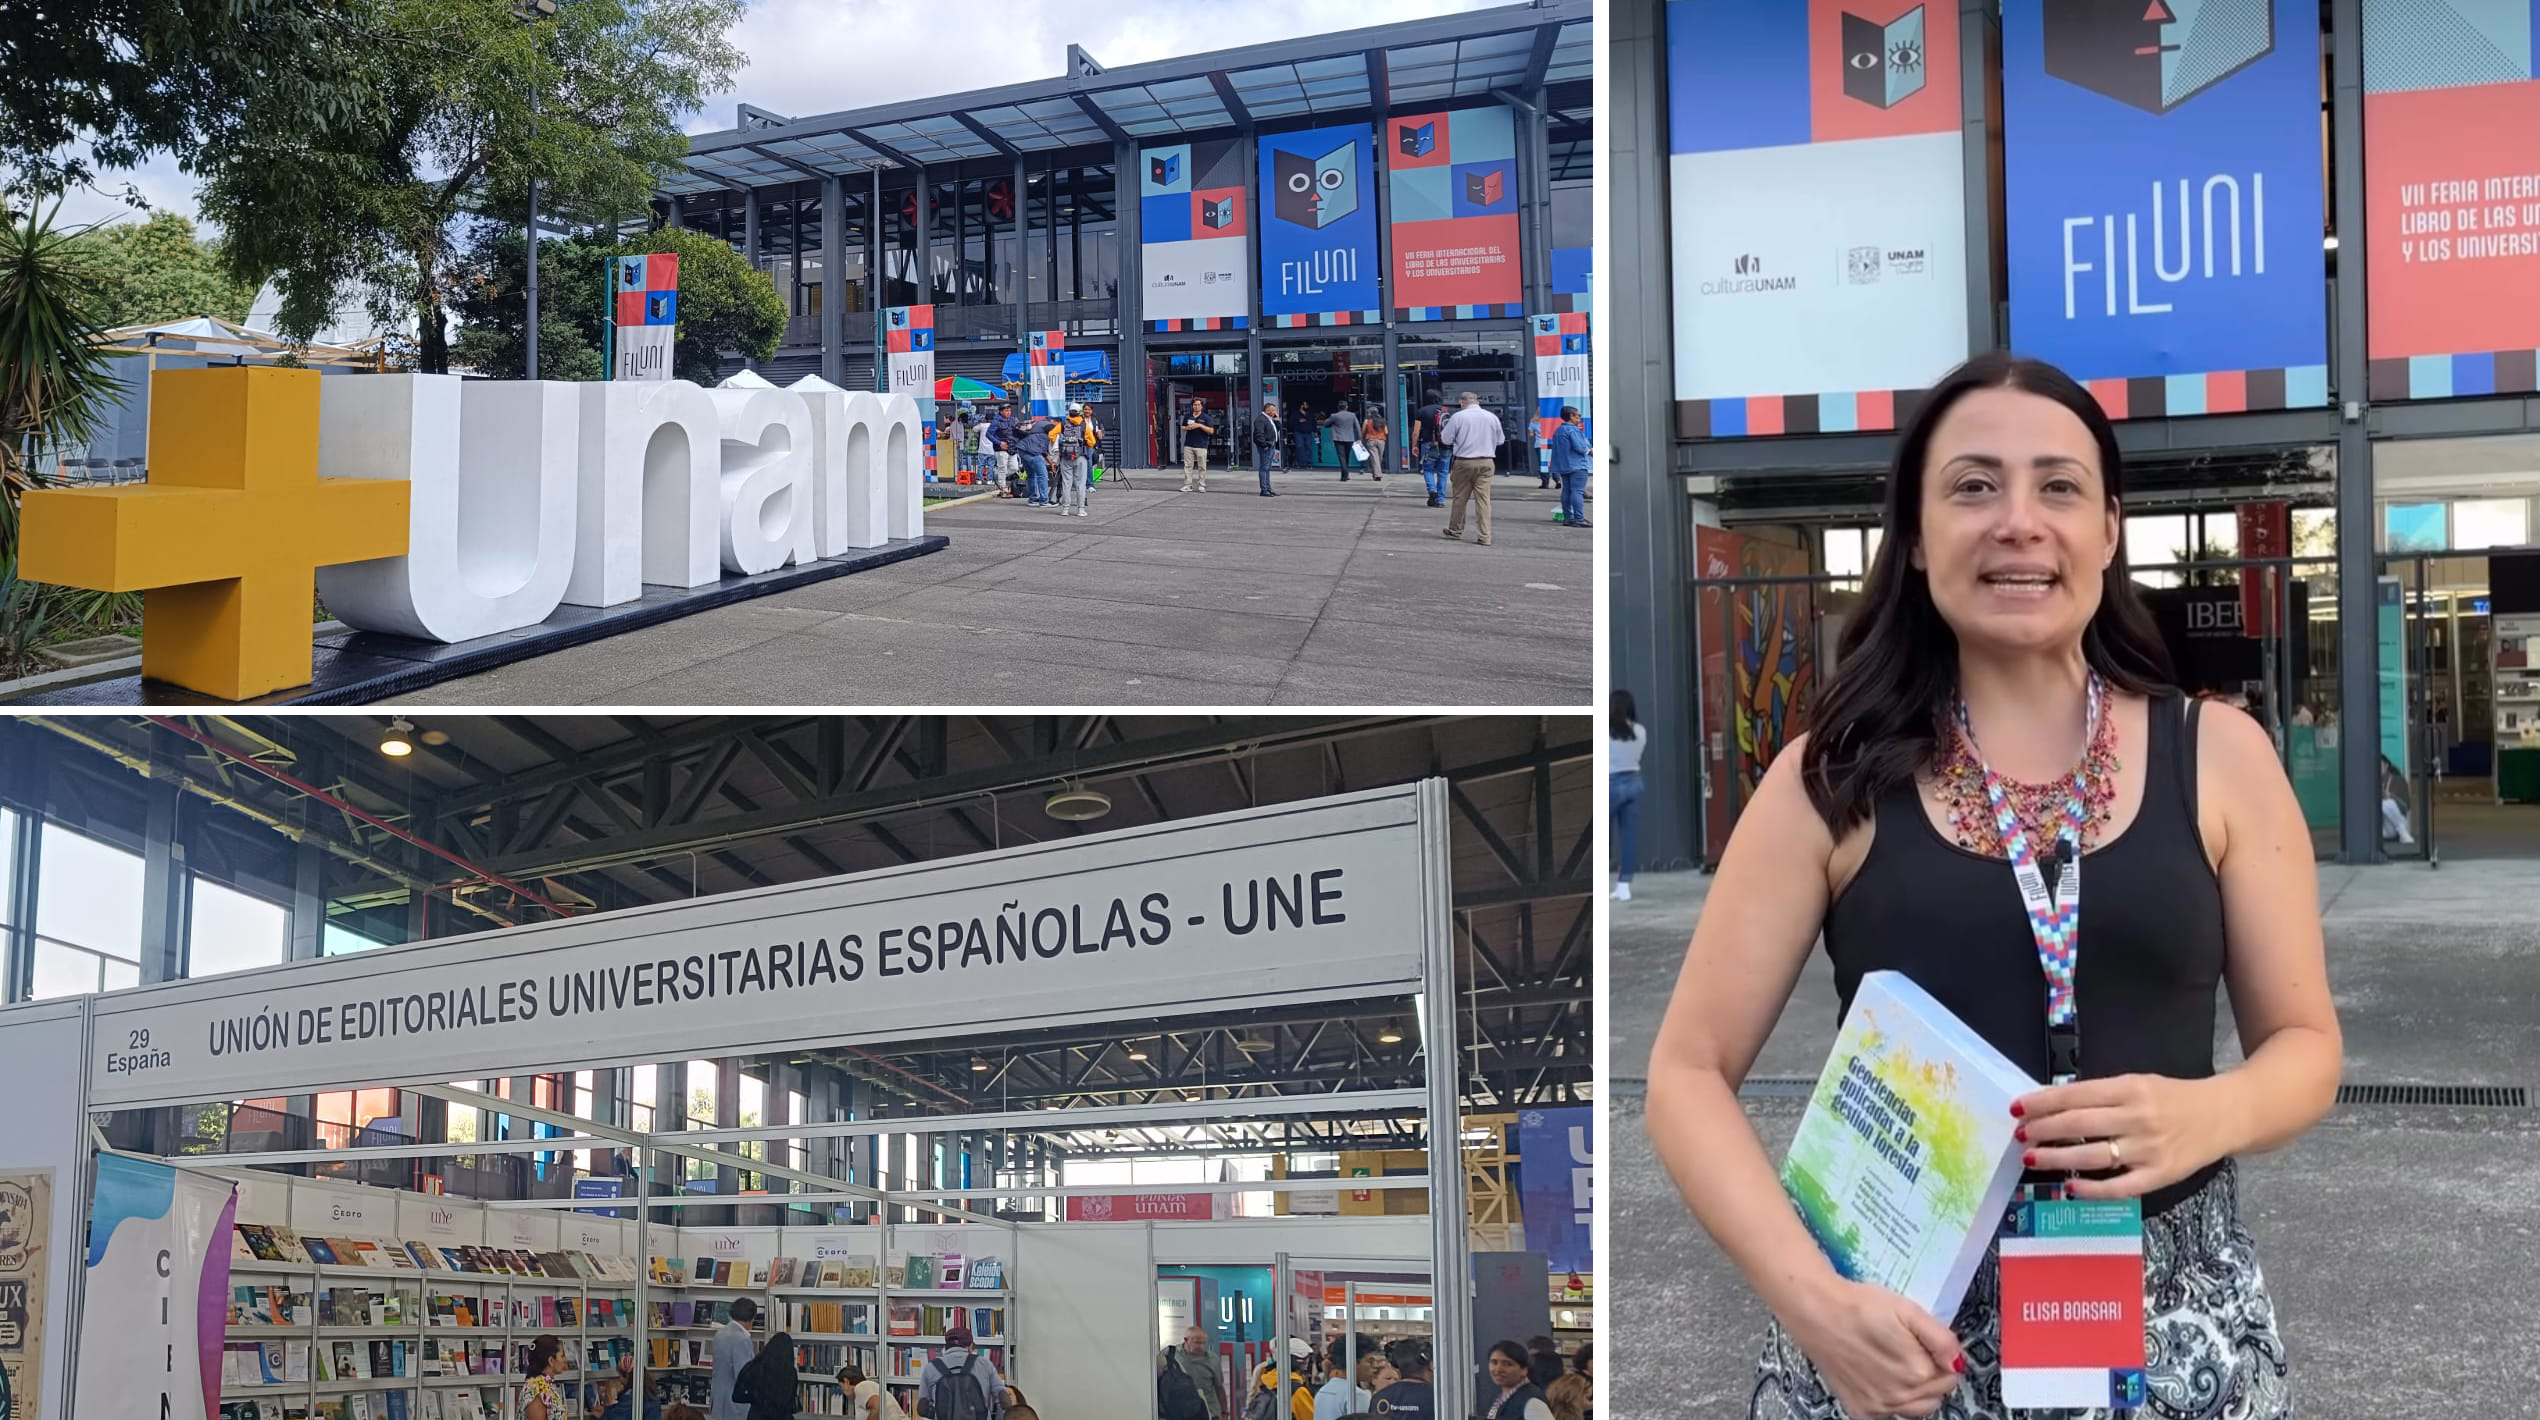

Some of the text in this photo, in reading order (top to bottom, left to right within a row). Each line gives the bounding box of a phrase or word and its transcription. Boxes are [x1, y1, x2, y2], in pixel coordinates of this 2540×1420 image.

[2401, 183, 2424, 207] VII
[2431, 179, 2478, 205] FERIA
[2401, 210, 2451, 235] LIBRO
[2457, 208, 2478, 231] DE
[2484, 205, 2516, 229] LAS
[1888, 249, 1925, 262] UNAM
[2063, 172, 2265, 319] FILUNI
[2402, 231, 2540, 264] Y LOS UNIVERSI
[1282, 248, 1357, 296] FILUNI
[624, 345, 663, 377] FILUNI
[896, 364, 928, 386] FILUNI
[1546, 366, 1581, 387] FILUNI
[209, 868, 1346, 1056] UNIÓN DE EDITORIALES UNIVERSITARIAS ESPAÑOLAS - UNE
[129, 1028, 150, 1051] 29
[107, 1048, 171, 1075] España
[1848, 1055, 1917, 1127] Geociencias
[1839, 1075, 1921, 1158] aplicadas a la
[1830, 1094, 1875, 1142] gestión
[1872, 1130, 1921, 1185] forestal
[2022, 1301, 2122, 1322] ELISA BORSARI
